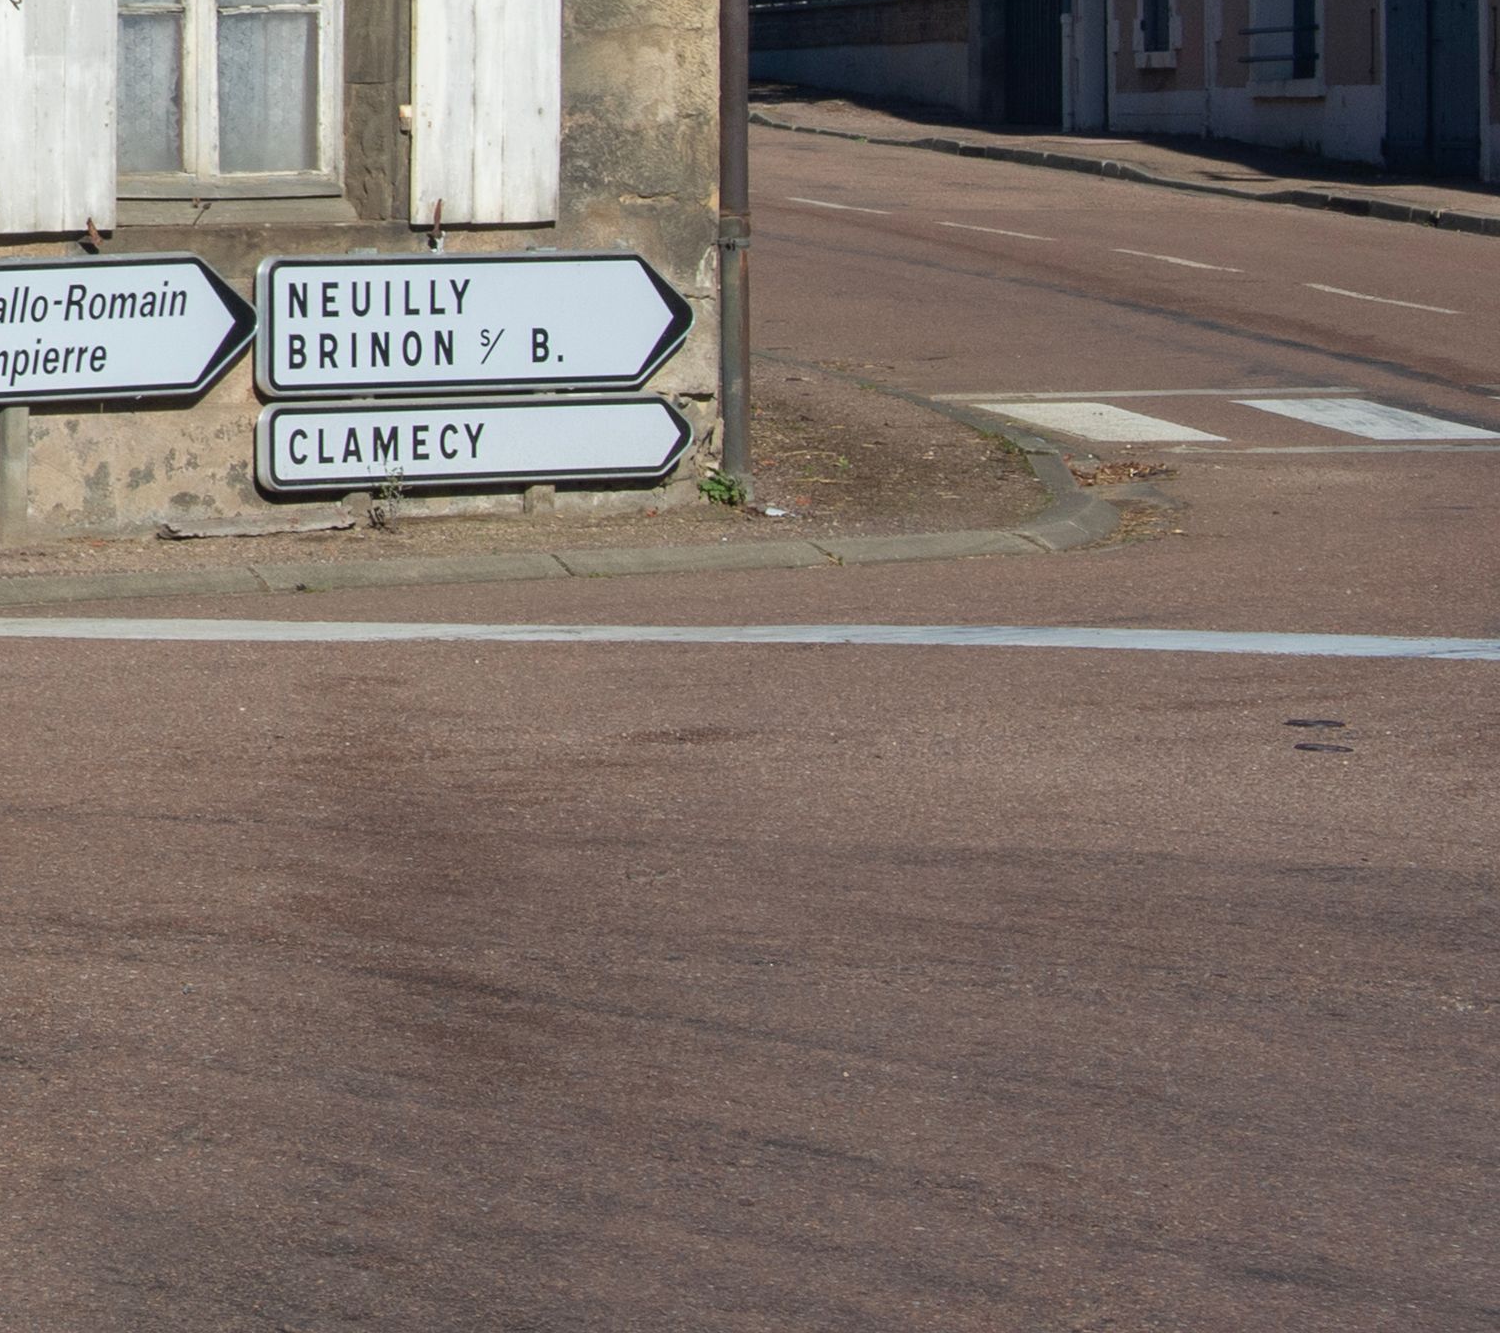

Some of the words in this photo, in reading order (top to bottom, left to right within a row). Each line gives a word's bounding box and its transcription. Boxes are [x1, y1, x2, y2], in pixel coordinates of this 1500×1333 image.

[288, 278, 471, 319] NEUILLY
[288, 329, 454, 371] BRINON
[531, 327, 564, 364] B.
[288, 422, 485, 466] CLAMECY
